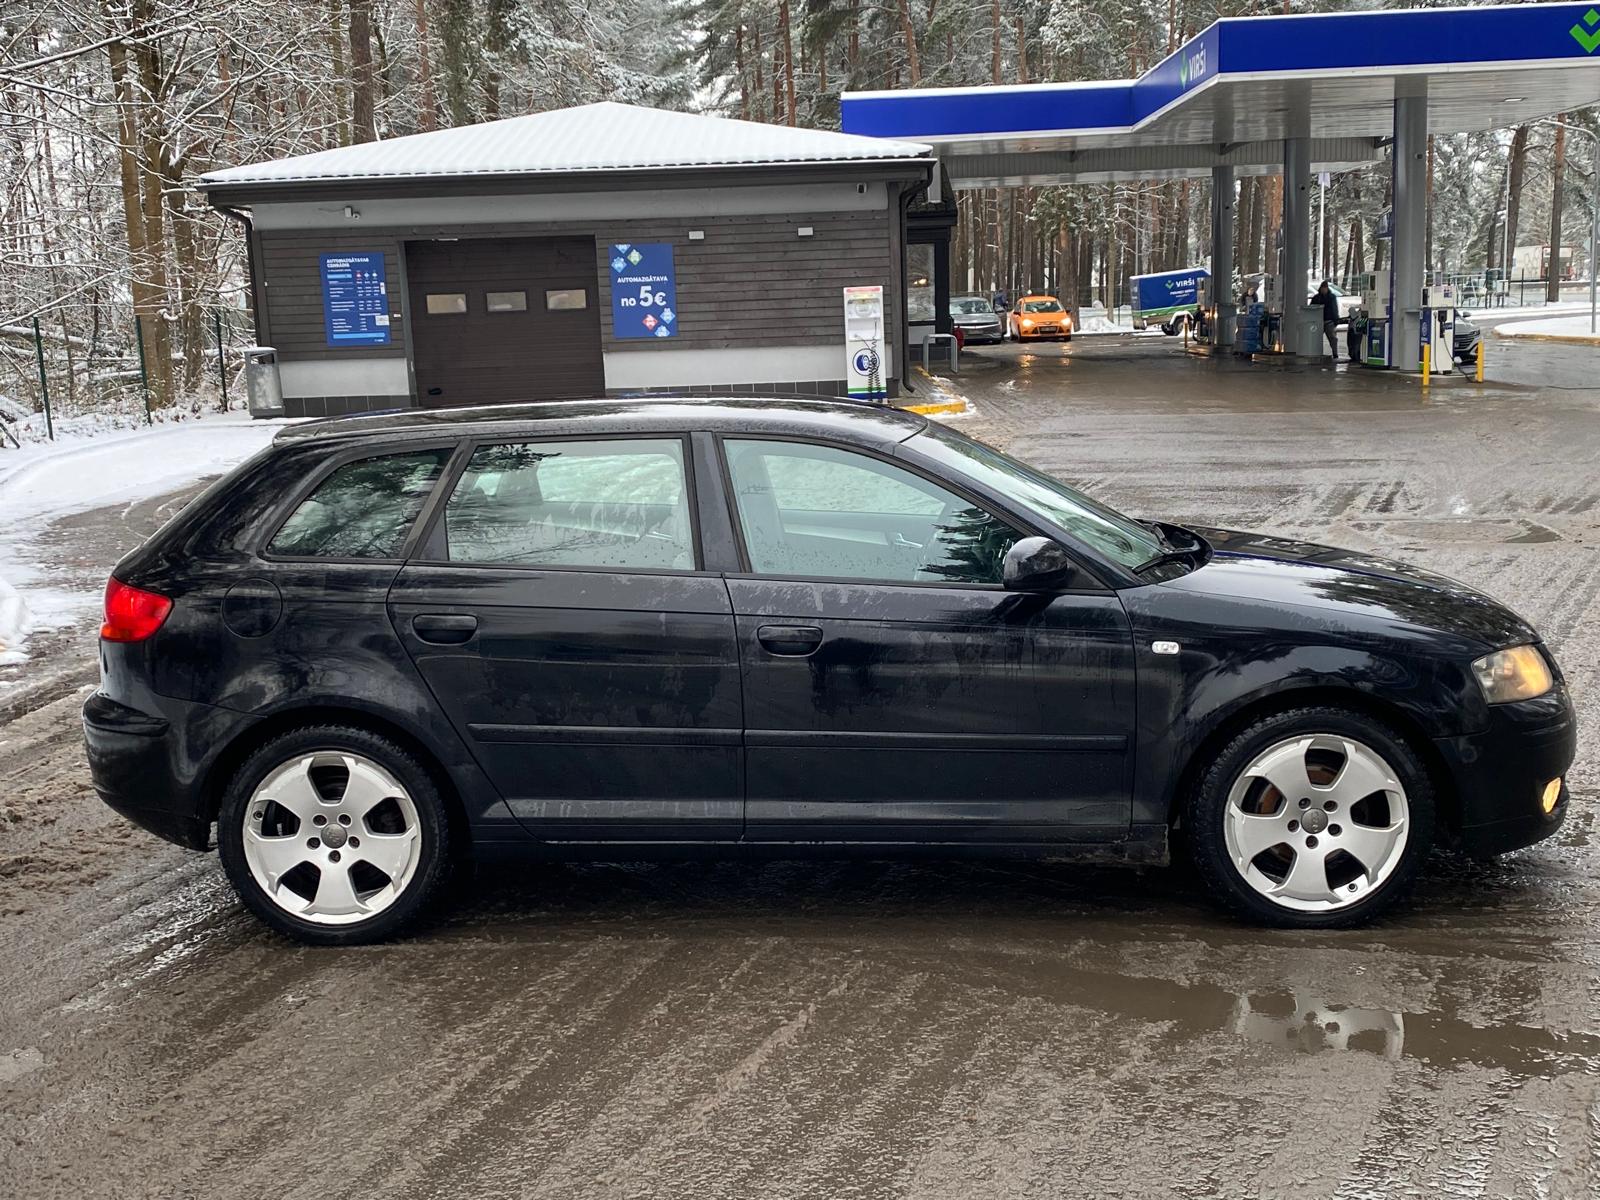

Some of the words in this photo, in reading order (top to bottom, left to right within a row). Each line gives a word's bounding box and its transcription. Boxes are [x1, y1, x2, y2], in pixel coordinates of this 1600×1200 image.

[1189, 42, 1207, 81] VIRŠI
[617, 275, 668, 283] AUTOMAZGĀTAVA
[1175, 278, 1195, 288] VIRŠI
[621, 297, 637, 307] no
[639, 285, 667, 307] 5€
